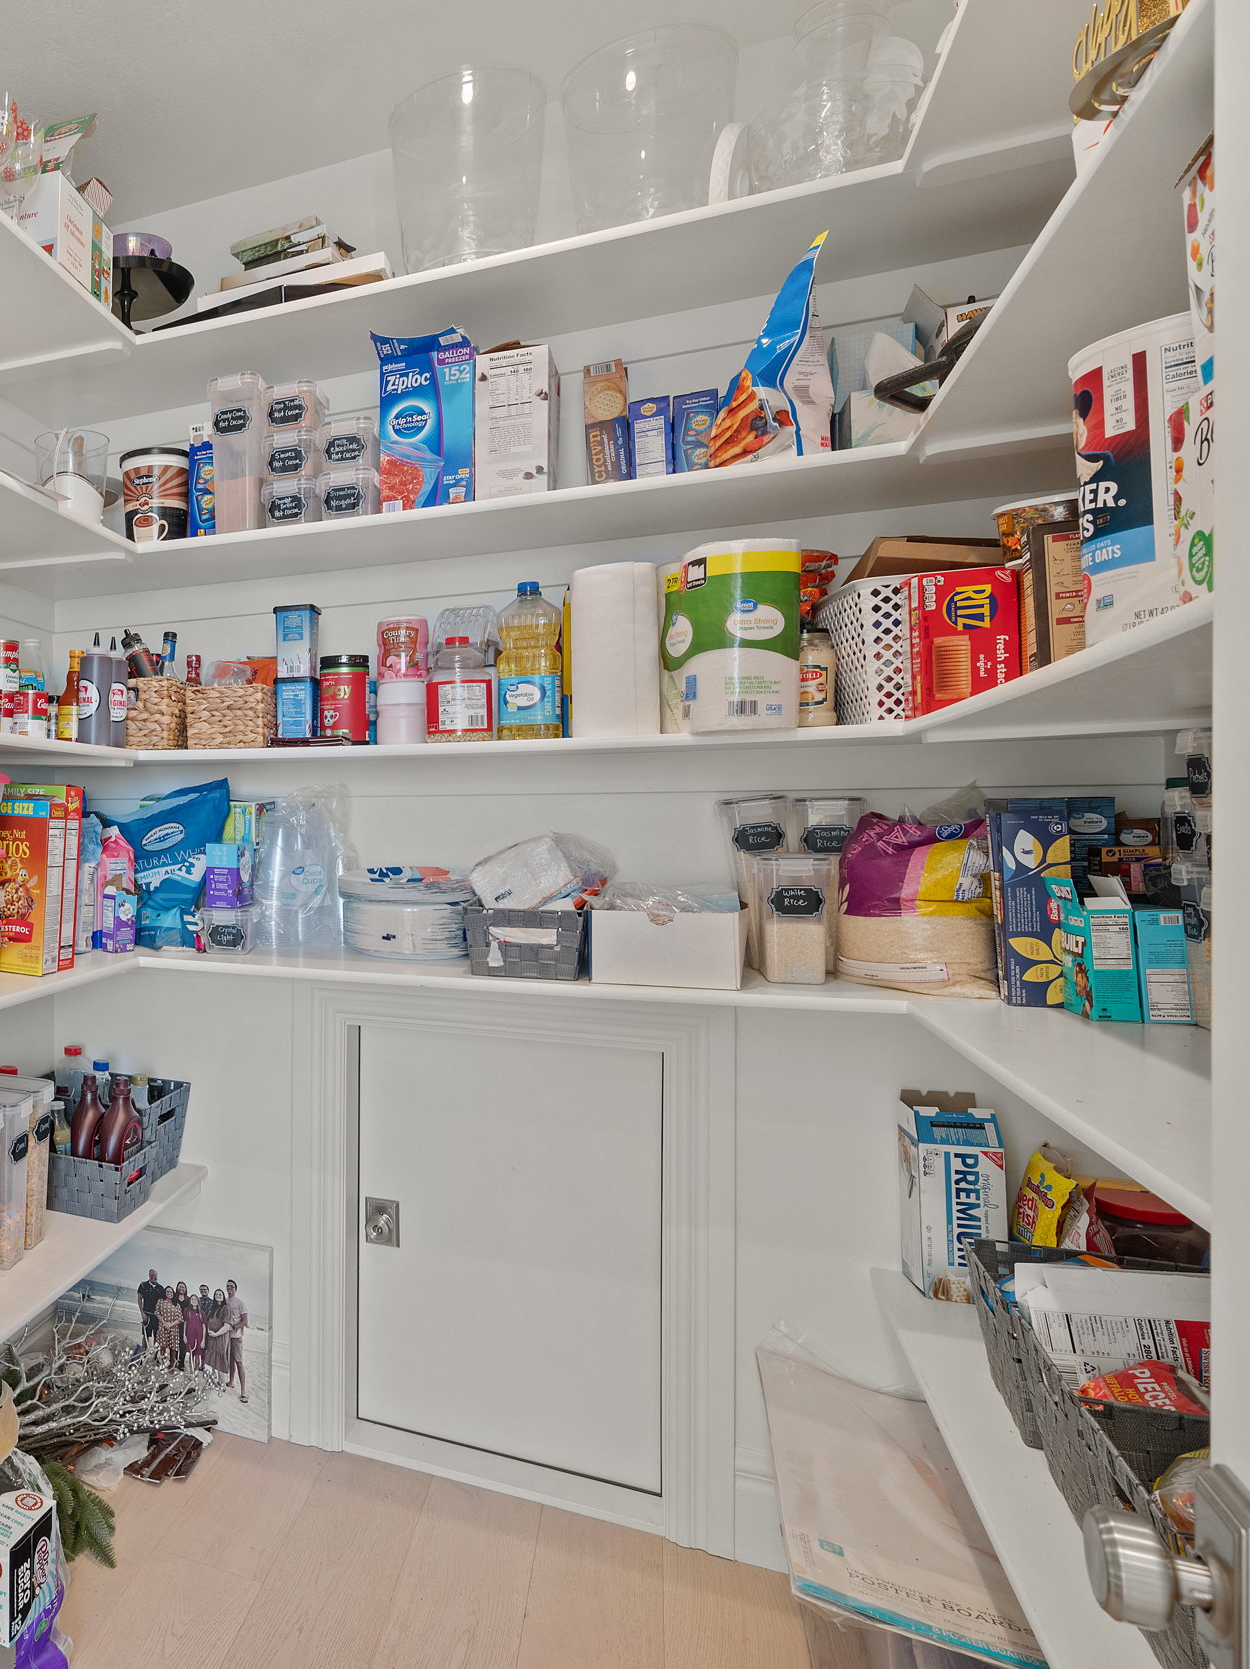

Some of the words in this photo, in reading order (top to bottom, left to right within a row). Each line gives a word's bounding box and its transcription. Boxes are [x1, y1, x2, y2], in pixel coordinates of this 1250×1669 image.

[1164, 341, 1194, 354] Nutrit
[438, 347, 470, 361] GALLON
[445, 355, 470, 364] FREEZER
[490, 354, 515, 362] Nutrition
[443, 365, 470, 382] 152
[1107, 364, 1128, 375] LASTING
[1107, 369, 1128, 381] ENERGY
[1165, 368, 1197, 381] Calories
[386, 371, 431, 393] Ziploc
[1110, 393, 1127, 404] FIBER
[217, 411, 232, 421] Candy
[272, 410, 284, 418] Hot
[285, 408, 302, 417] Cocoa
[230, 418, 244, 426] Cocoa
[394, 420, 426, 430] Technology
[273, 459, 284, 467] Hot
[285, 457, 302, 466] Cocoa
[618, 448, 628, 475] ORIGINAL
[667, 578, 672, 589] 2
[954, 584, 992, 631] RITZ
[1134, 609, 1148, 620] NET
[1148, 607, 1158, 617] WT
[734, 617, 752, 626] Ultra
[753, 617, 778, 627] Strong
[383, 628, 415, 639] Country
[388, 636, 410, 644] Time
[976, 653, 988, 678] original
[508, 691, 535, 699] Vegetable
[544, 677, 552, 716] BAKING
[14, 802, 34, 815] SIZE
[745, 826, 777, 834] Jasmine
[813, 829, 849, 837] Jasmine
[749, 835, 771, 845] Rice
[816, 839, 842, 848] Rice
[783, 888, 807, 897] White
[784, 897, 808, 906] Rice
[218, 926, 237, 934] Crystal
[217, 933, 235, 944] Light
[15, 1138, 27, 1154] Cereal
[974, 1173, 999, 1209] original
[953, 1152, 982, 1268] PREMIUM
[1017, 1203, 1037, 1231] Fish
[1136, 1318, 1146, 1341] Calories
[1143, 1344, 1153, 1360] 280
[1164, 1320, 1175, 1345] Nutrition
[1170, 1346, 1180, 1362] Facts
[1125, 1388, 1142, 1403] HOT
[1, 1503, 14, 1512] SAVE
[14, 1508, 35, 1522] RECEIPT
[10, 1518, 25, 1528] CODE
[848, 1571, 934, 1606] POSTER
[941, 1602, 1036, 1637] BOARDS
